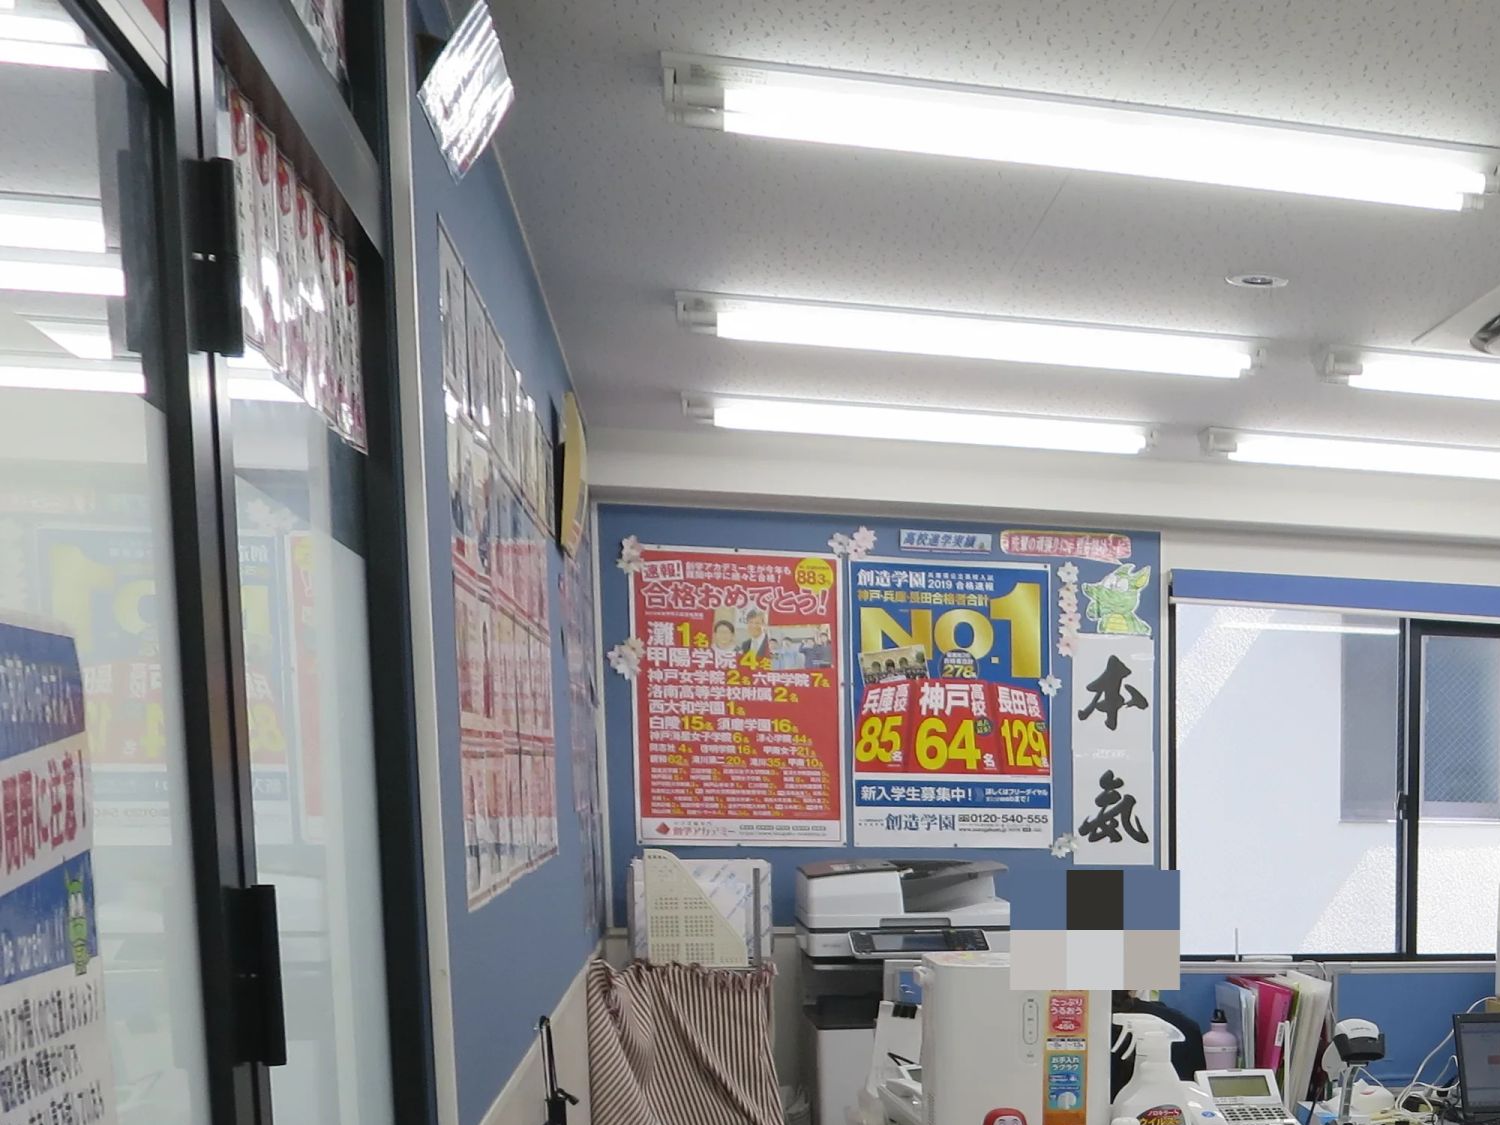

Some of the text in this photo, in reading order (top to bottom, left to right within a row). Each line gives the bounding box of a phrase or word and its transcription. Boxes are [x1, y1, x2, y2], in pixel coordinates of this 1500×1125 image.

[857, 569, 925, 588] 創造学園
[928, 580, 952, 589] 2019
[641, 581, 829, 615] 合格おめでとう！
[861, 682, 1041, 718] 兵庫高校 神戸高校 長田高校
[861, 786, 973, 802] 新入学生募集中！
[885, 813, 956, 832] 創造学園
[970, 814, 1049, 823] 0120-540-555
